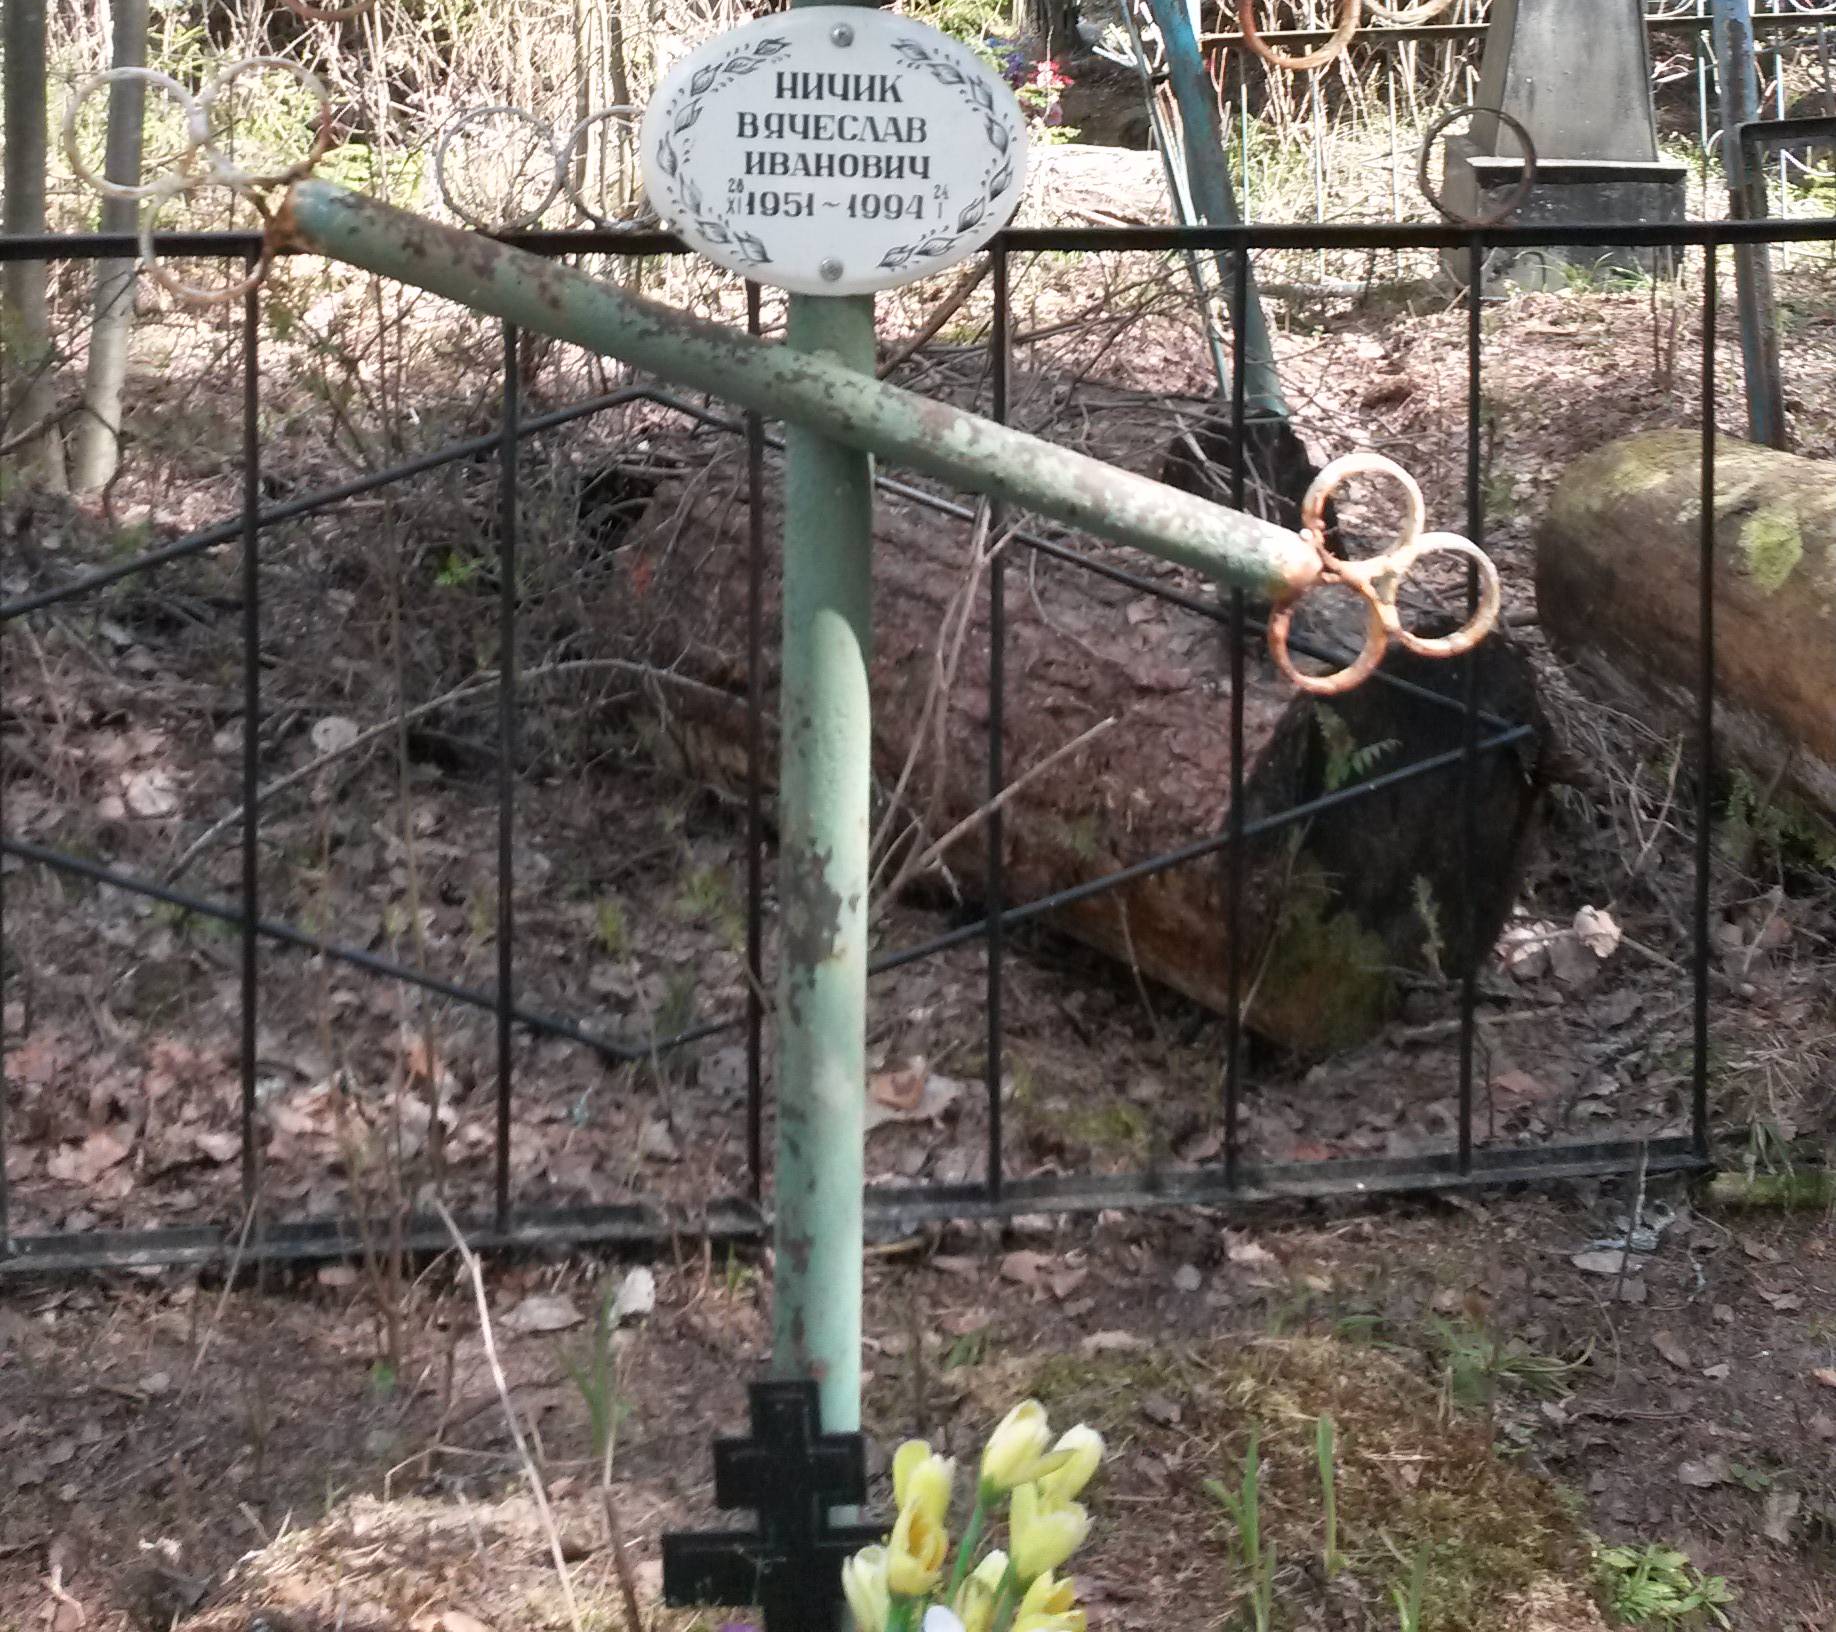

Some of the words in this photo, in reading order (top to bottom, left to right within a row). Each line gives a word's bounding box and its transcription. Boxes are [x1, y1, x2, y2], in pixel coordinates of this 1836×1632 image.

[775, 72, 903, 103] НИЧИК
[737, 111, 927, 143] ВЯЧЕСЛАВ
[744, 151, 931, 180] ИВАНОВИЧ
